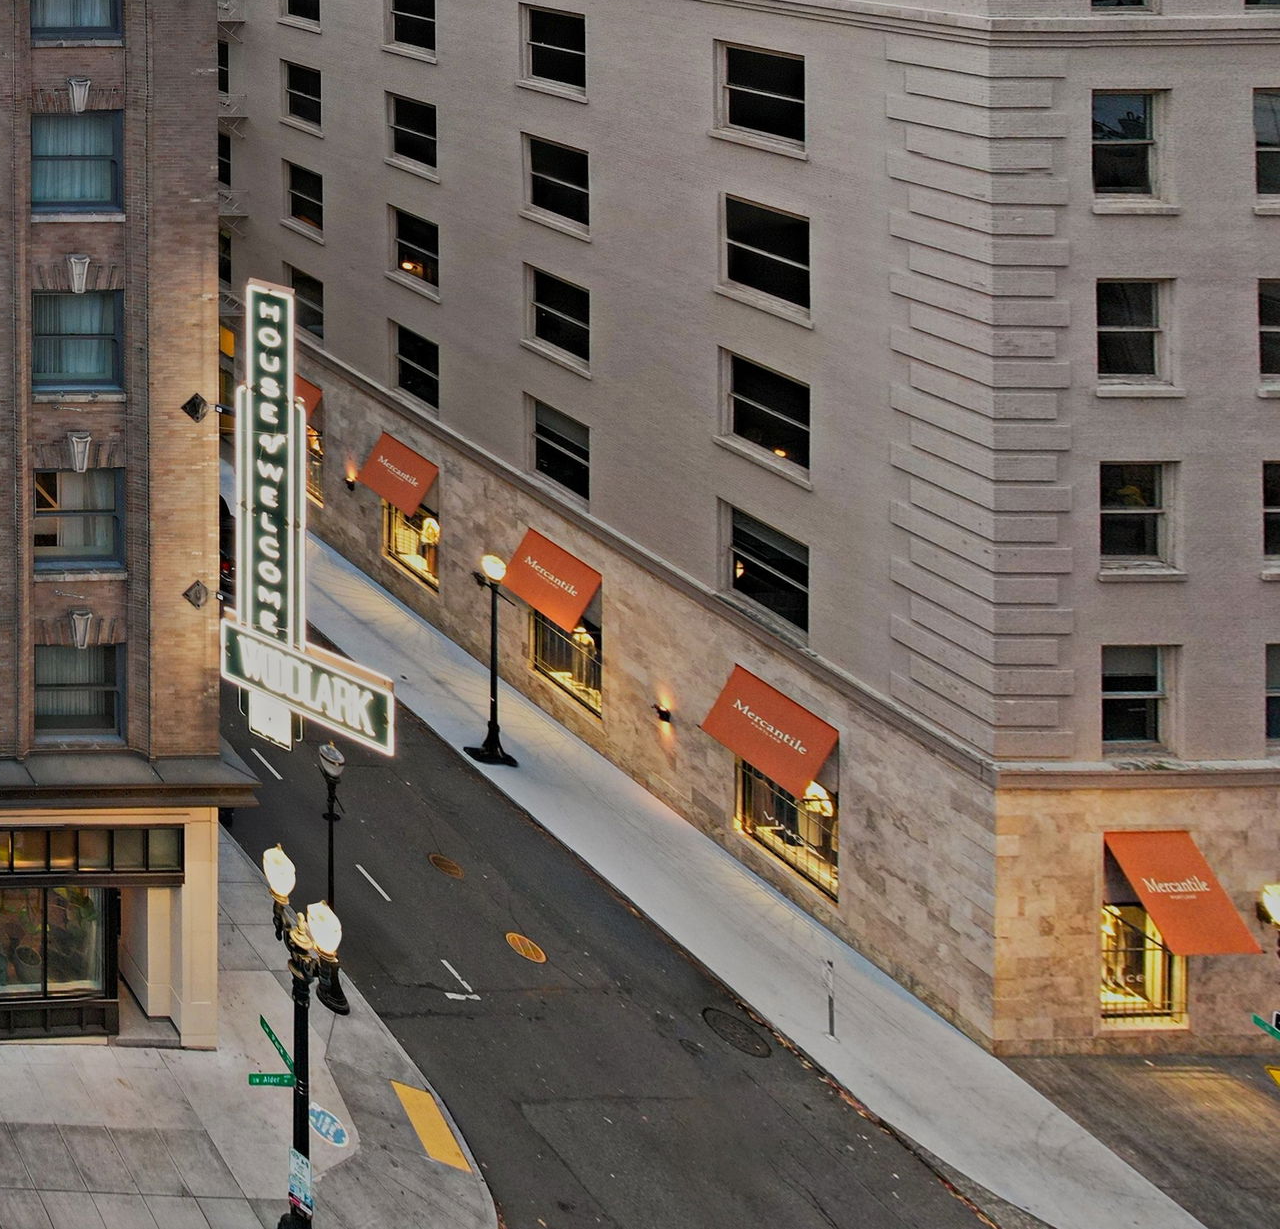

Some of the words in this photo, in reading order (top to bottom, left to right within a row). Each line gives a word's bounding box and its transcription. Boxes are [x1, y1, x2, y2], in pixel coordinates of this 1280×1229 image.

[258, 301, 282, 424] HOUSE
[378, 455, 419, 487] Mercantile
[257, 459, 282, 634] WELCOME
[523, 555, 578, 597] Mercantile
[236, 634, 377, 737] WOODLARK
[732, 698, 808, 755] Mercantile
[1142, 875, 1211, 894] Mercantile
[263, 1075, 280, 1084] Alder
